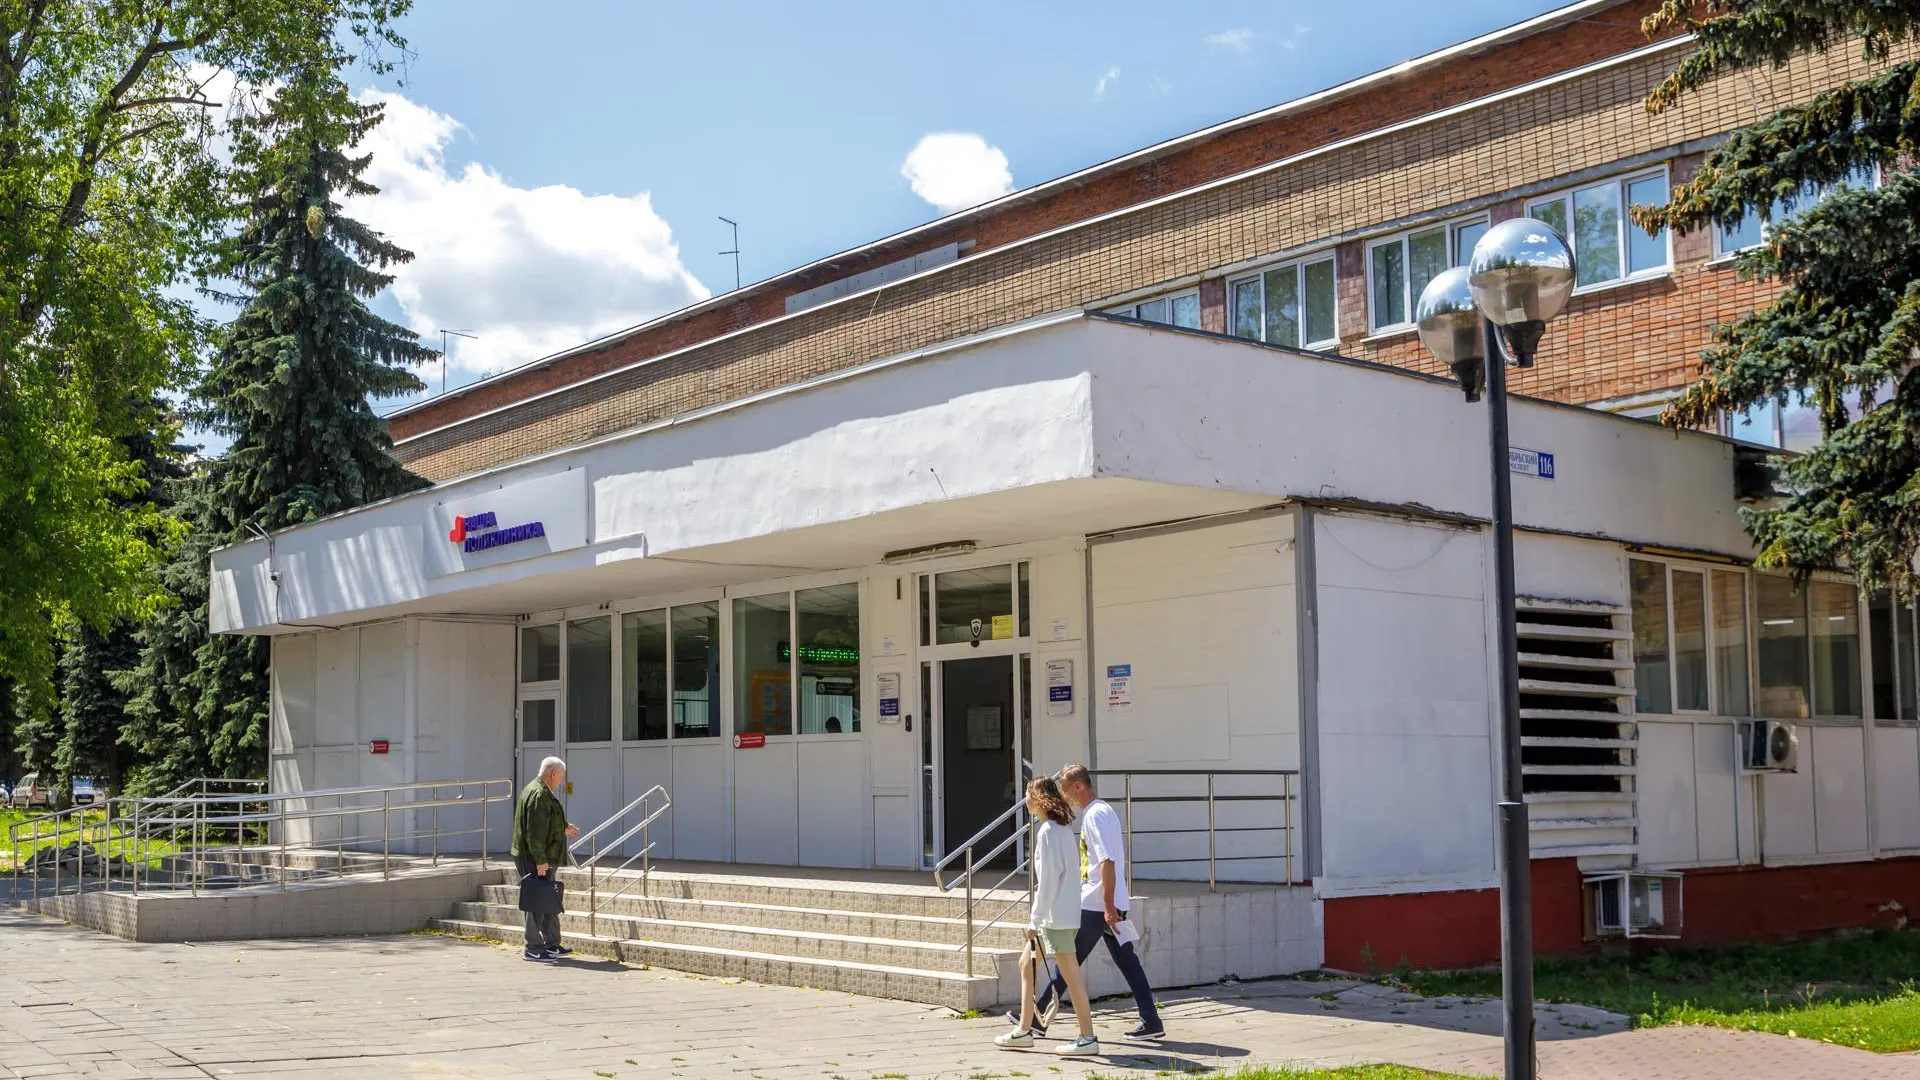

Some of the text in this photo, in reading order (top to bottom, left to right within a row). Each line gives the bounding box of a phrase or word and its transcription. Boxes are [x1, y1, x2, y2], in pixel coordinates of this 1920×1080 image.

[1539, 456, 1553, 475] 116
[464, 511, 497, 532] НАША
[464, 521, 546, 553] ПОЛИКЛИНИКА
